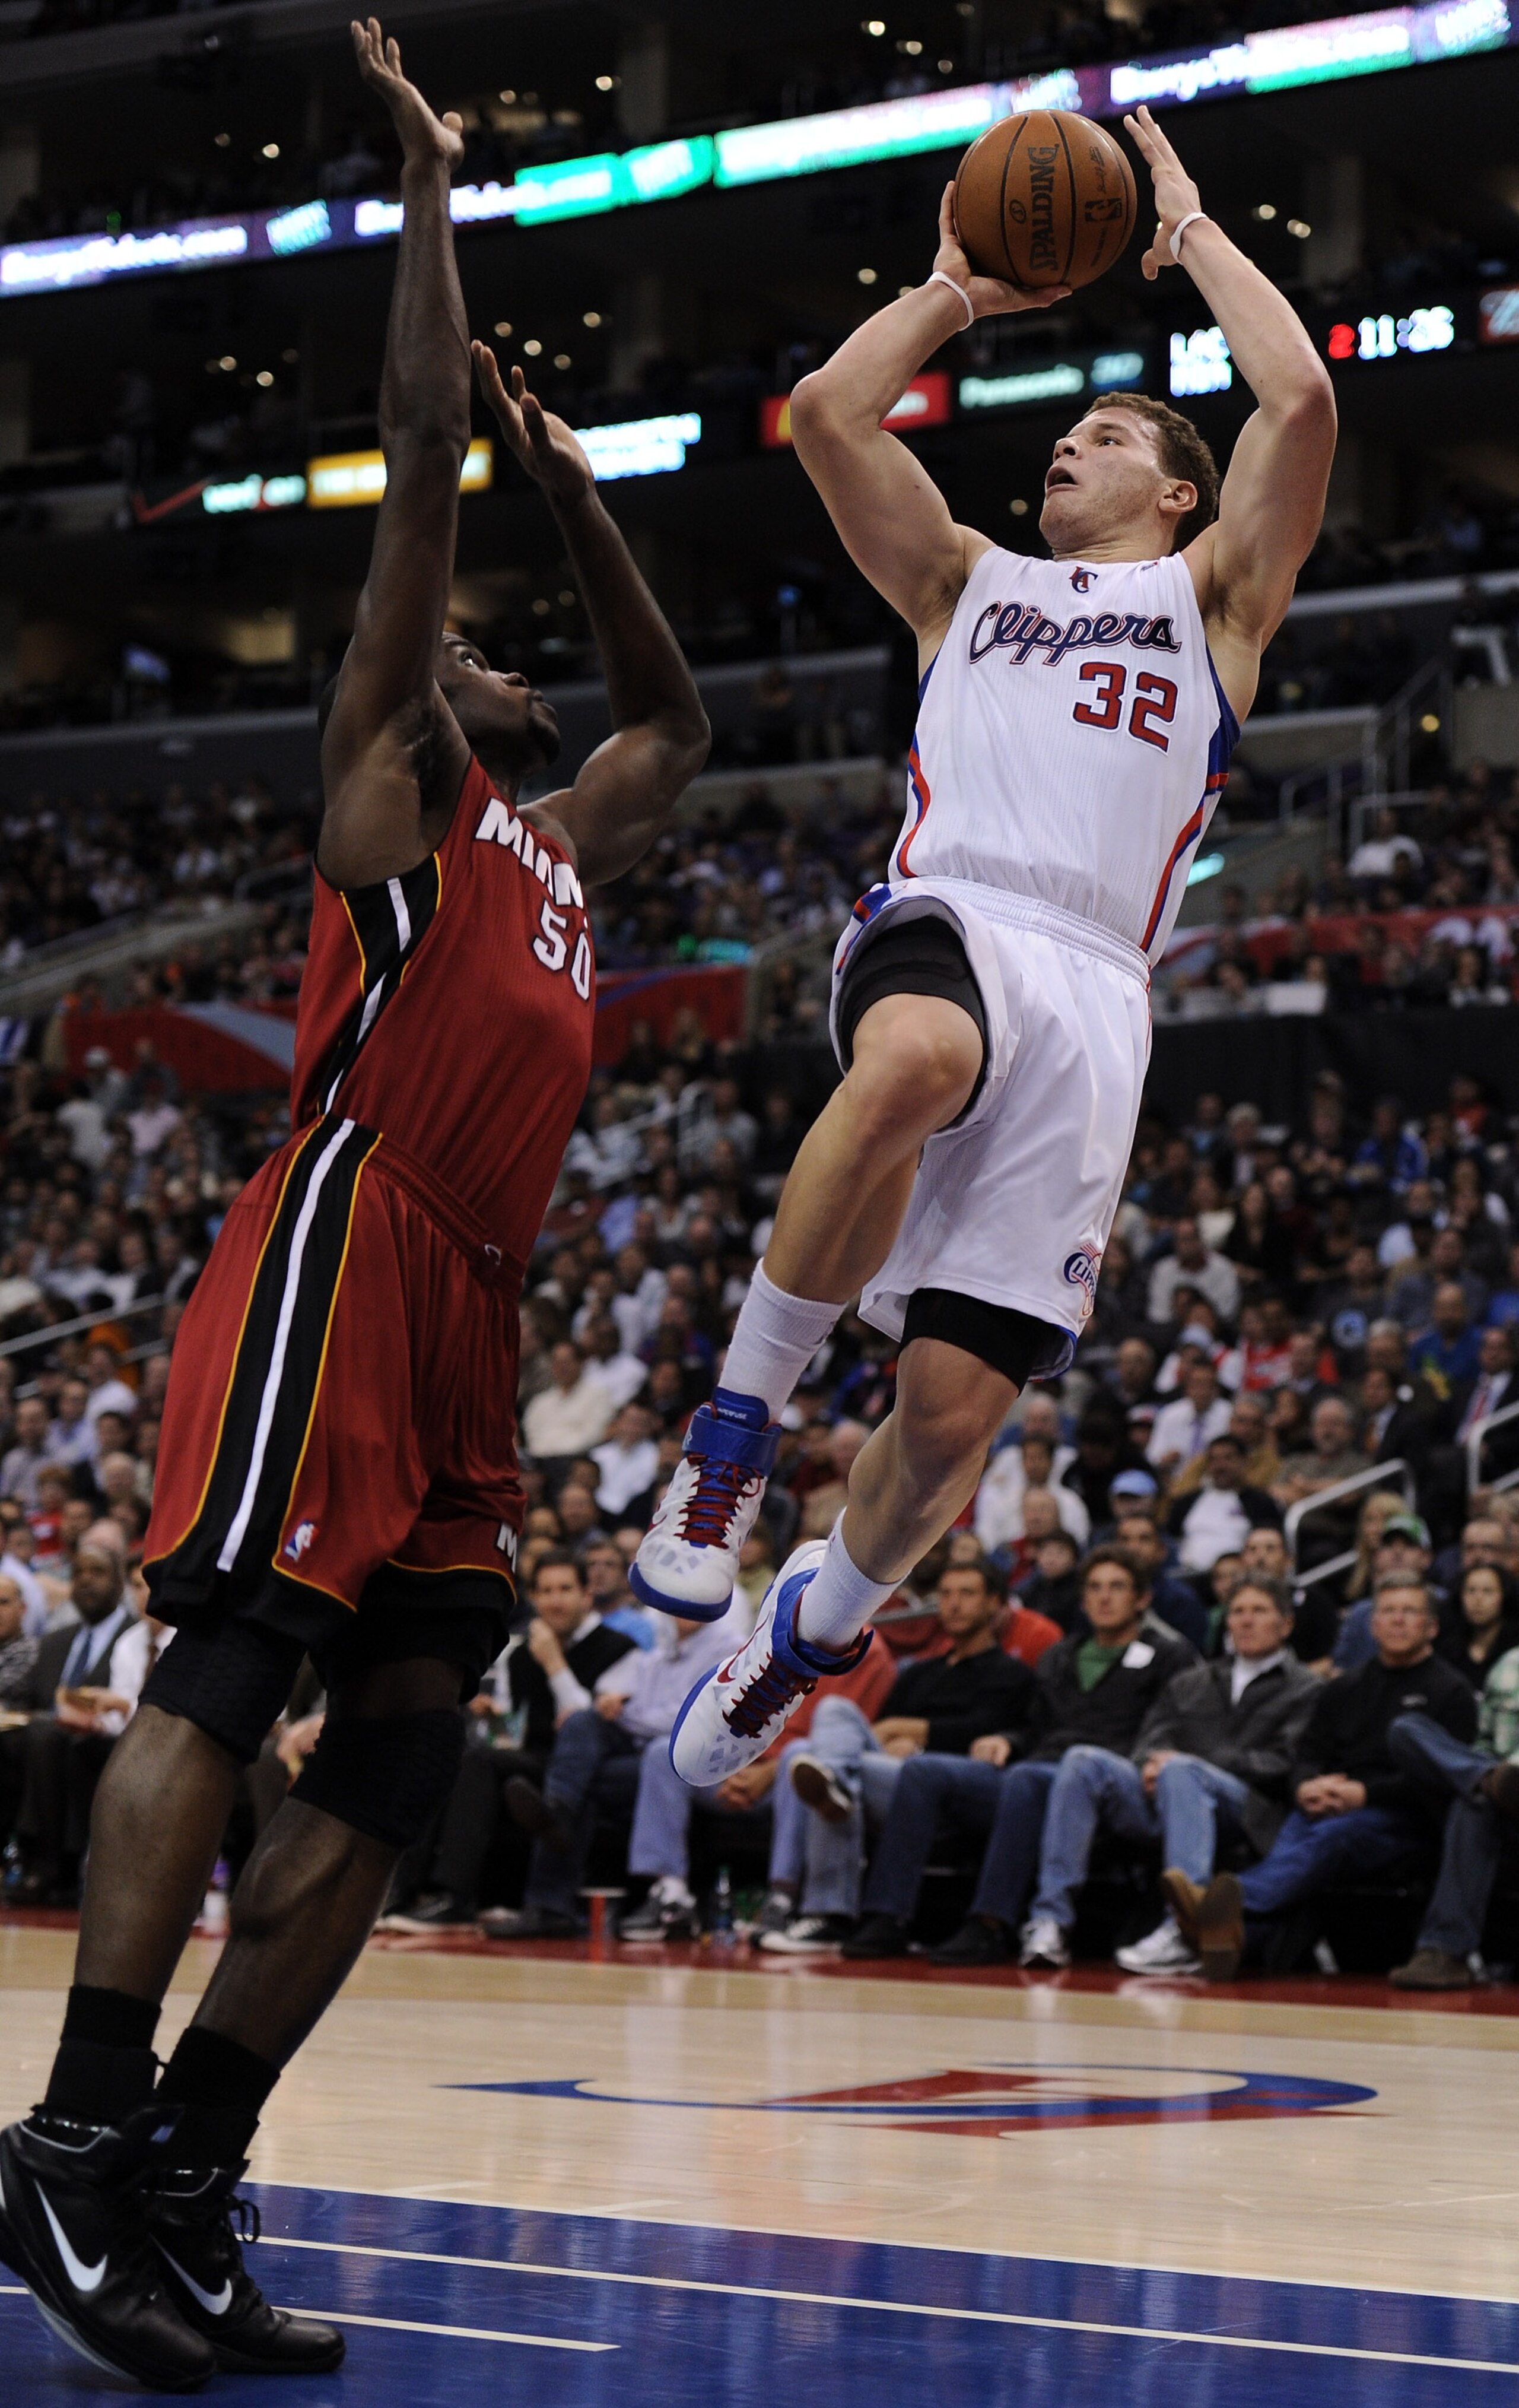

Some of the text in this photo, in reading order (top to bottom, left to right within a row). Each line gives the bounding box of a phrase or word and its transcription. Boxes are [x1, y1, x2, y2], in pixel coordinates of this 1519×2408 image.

[1028, 146, 1059, 271] SPALDING
[969, 601, 1182, 667] Clippers
[1072, 661, 1179, 757] 32
[475, 797, 588, 929] MIAM
[533, 899, 592, 1001] 50
